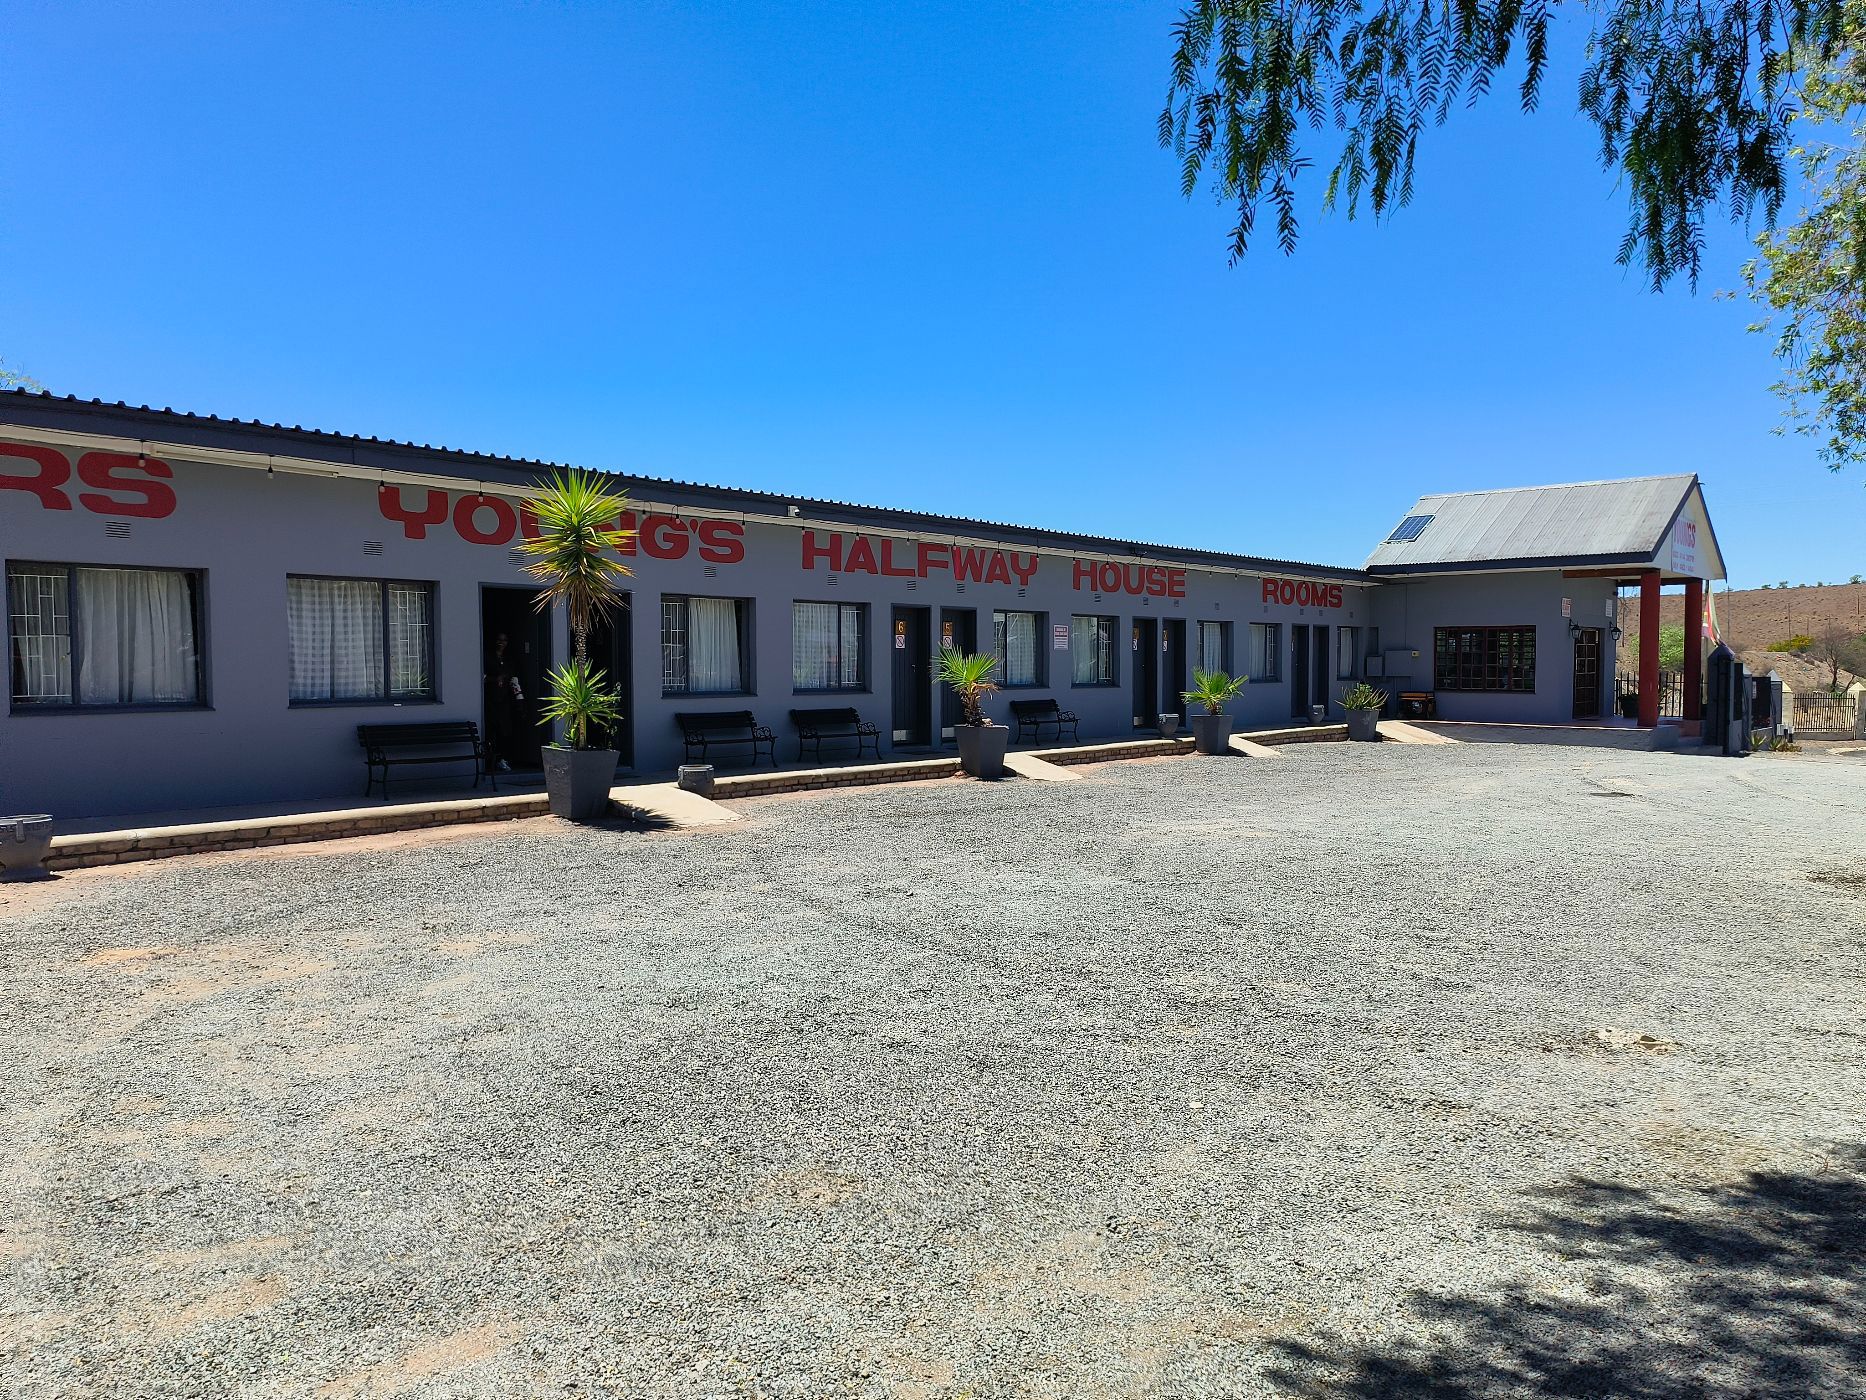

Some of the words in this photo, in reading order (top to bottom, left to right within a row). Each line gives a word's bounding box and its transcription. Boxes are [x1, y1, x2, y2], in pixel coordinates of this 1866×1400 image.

[801, 530, 1038, 586] HALFWAY
[1072, 559, 1186, 598] HOUSE
[1262, 578, 1343, 608] ROOMS
